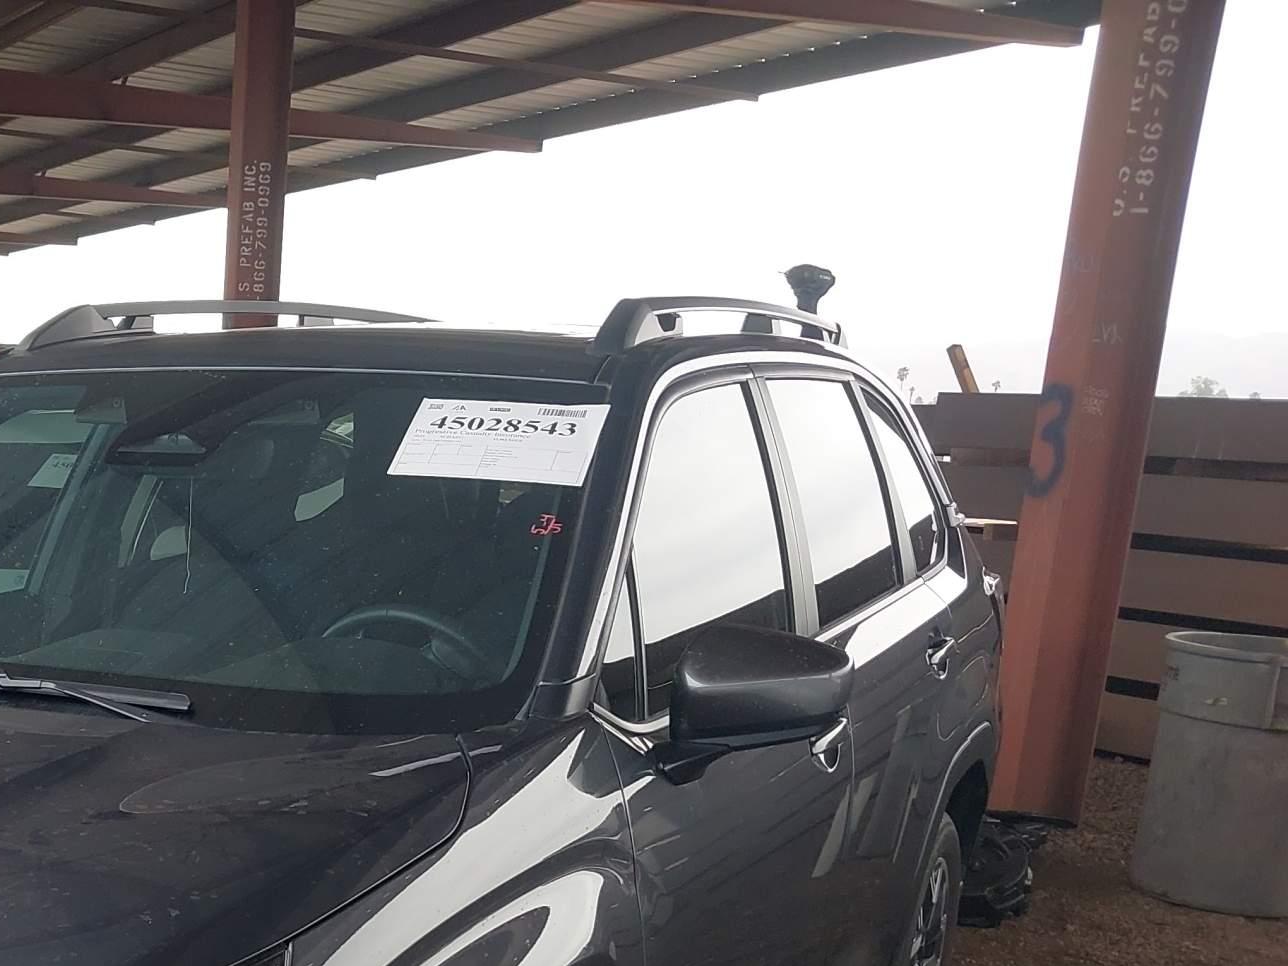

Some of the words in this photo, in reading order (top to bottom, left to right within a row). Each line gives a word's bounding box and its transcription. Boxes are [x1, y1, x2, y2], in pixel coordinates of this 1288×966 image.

[239, 201, 255, 267] PREFAB
[253, 161, 272, 301] -866-799-0969
[430, 415, 577, 438] 45028543
[1024, 383, 1074, 497] 3
